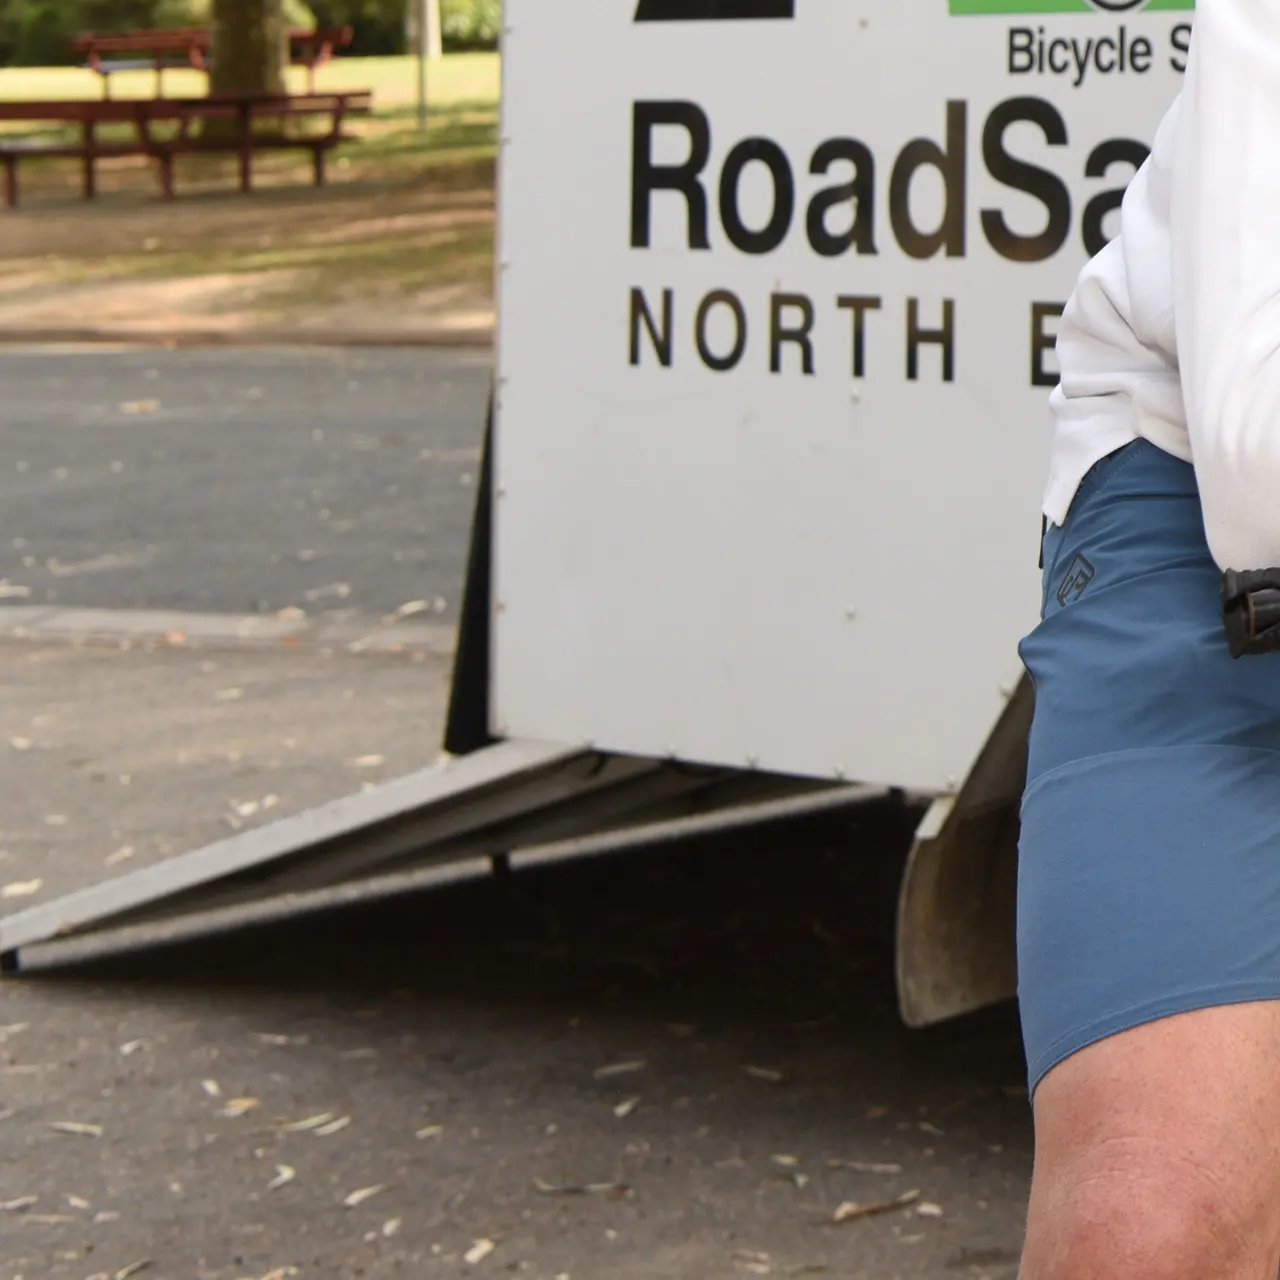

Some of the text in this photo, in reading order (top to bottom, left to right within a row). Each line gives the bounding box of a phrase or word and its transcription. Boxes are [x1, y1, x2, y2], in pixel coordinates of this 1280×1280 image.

[1008, 24, 1153, 87] Bicycle
[629, 96, 1152, 262] RoadSa
[628, 286, 955, 383] NORTH
